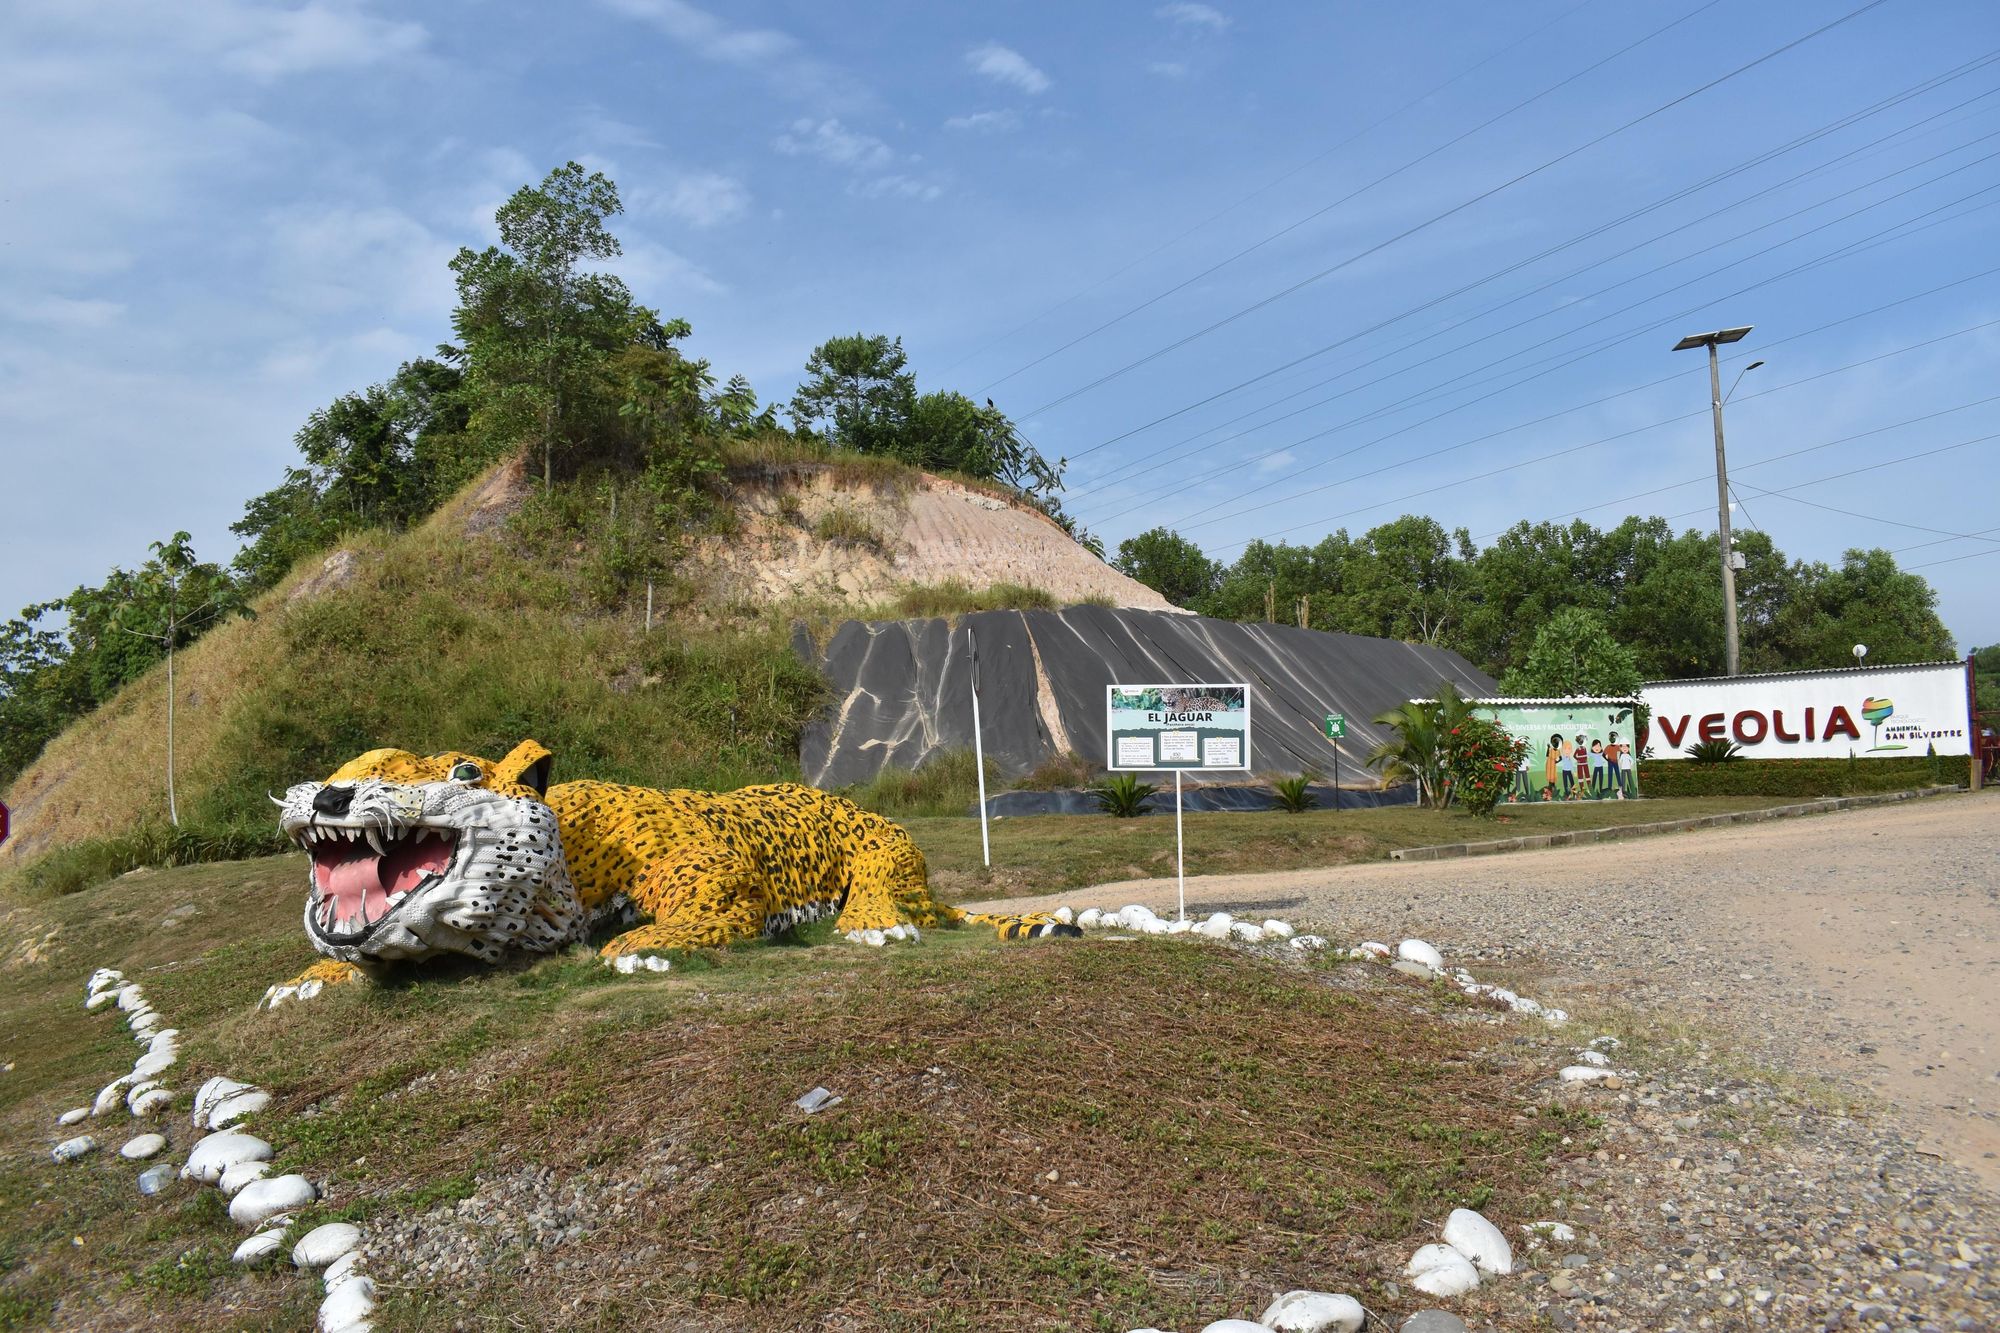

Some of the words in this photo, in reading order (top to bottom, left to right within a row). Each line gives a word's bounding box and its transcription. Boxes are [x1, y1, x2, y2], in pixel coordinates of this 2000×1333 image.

[1148, 713, 1161, 722] EL
[1164, 712, 1213, 724] JAGUAR
[1657, 706, 1861, 748] VEOLIA
[1885, 732, 1905, 740] SAN
[1909, 730, 1962, 739] SILVESTRE
